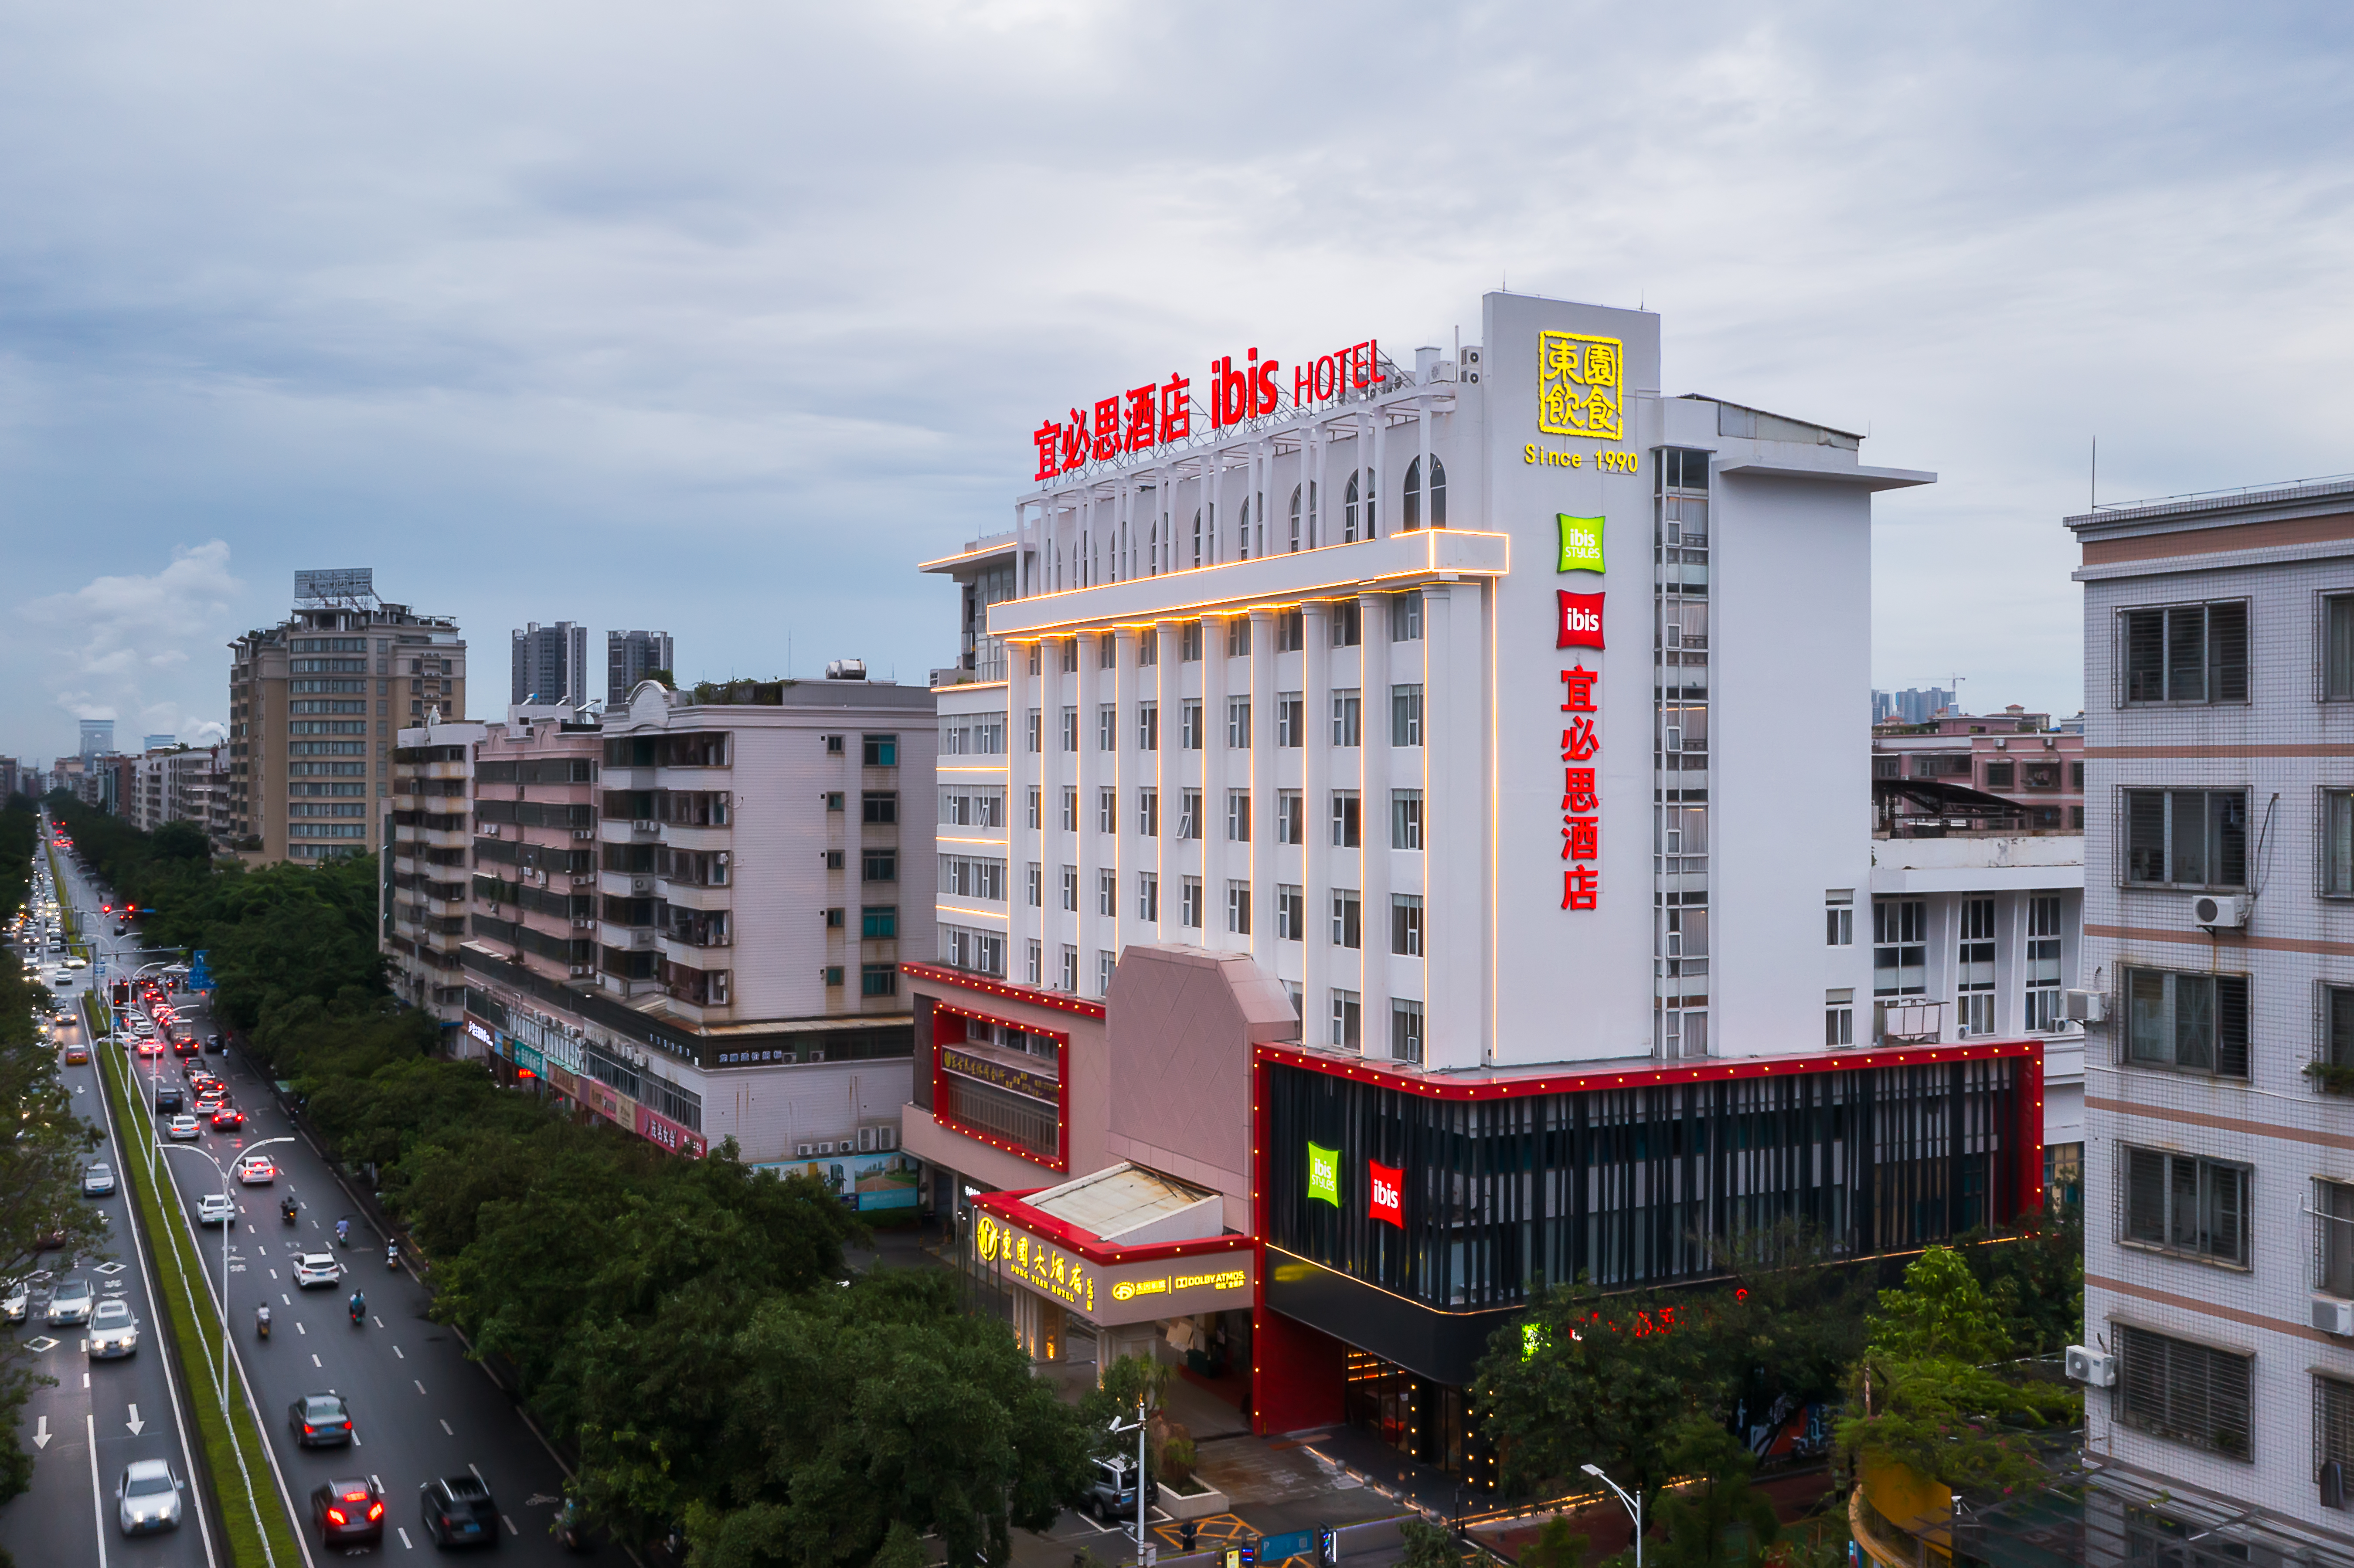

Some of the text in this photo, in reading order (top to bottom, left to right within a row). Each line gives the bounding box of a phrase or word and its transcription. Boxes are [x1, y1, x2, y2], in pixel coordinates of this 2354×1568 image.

[1544, 339, 1616, 387] 東園
[1211, 339, 1386, 429] ibis HOTEL
[1545, 381, 1617, 431] 飲食
[1034, 372, 1190, 482] 宜必思酒店
[1525, 444, 1638, 472] Since 1990
[1570, 528, 1595, 546] ibis
[1567, 608, 1599, 631] ibis
[1561, 665, 1600, 910] 宜必思酒店
[1315, 1158, 1332, 1179] ibis
[1374, 1179, 1398, 1208] ibis
[1011, 1263, 1029, 1280] DONG
[1031, 1274, 1048, 1290] YUAN
[1051, 1284, 1075, 1303] HOTEL
[1188, 1274, 1215, 1286] DOLBY
